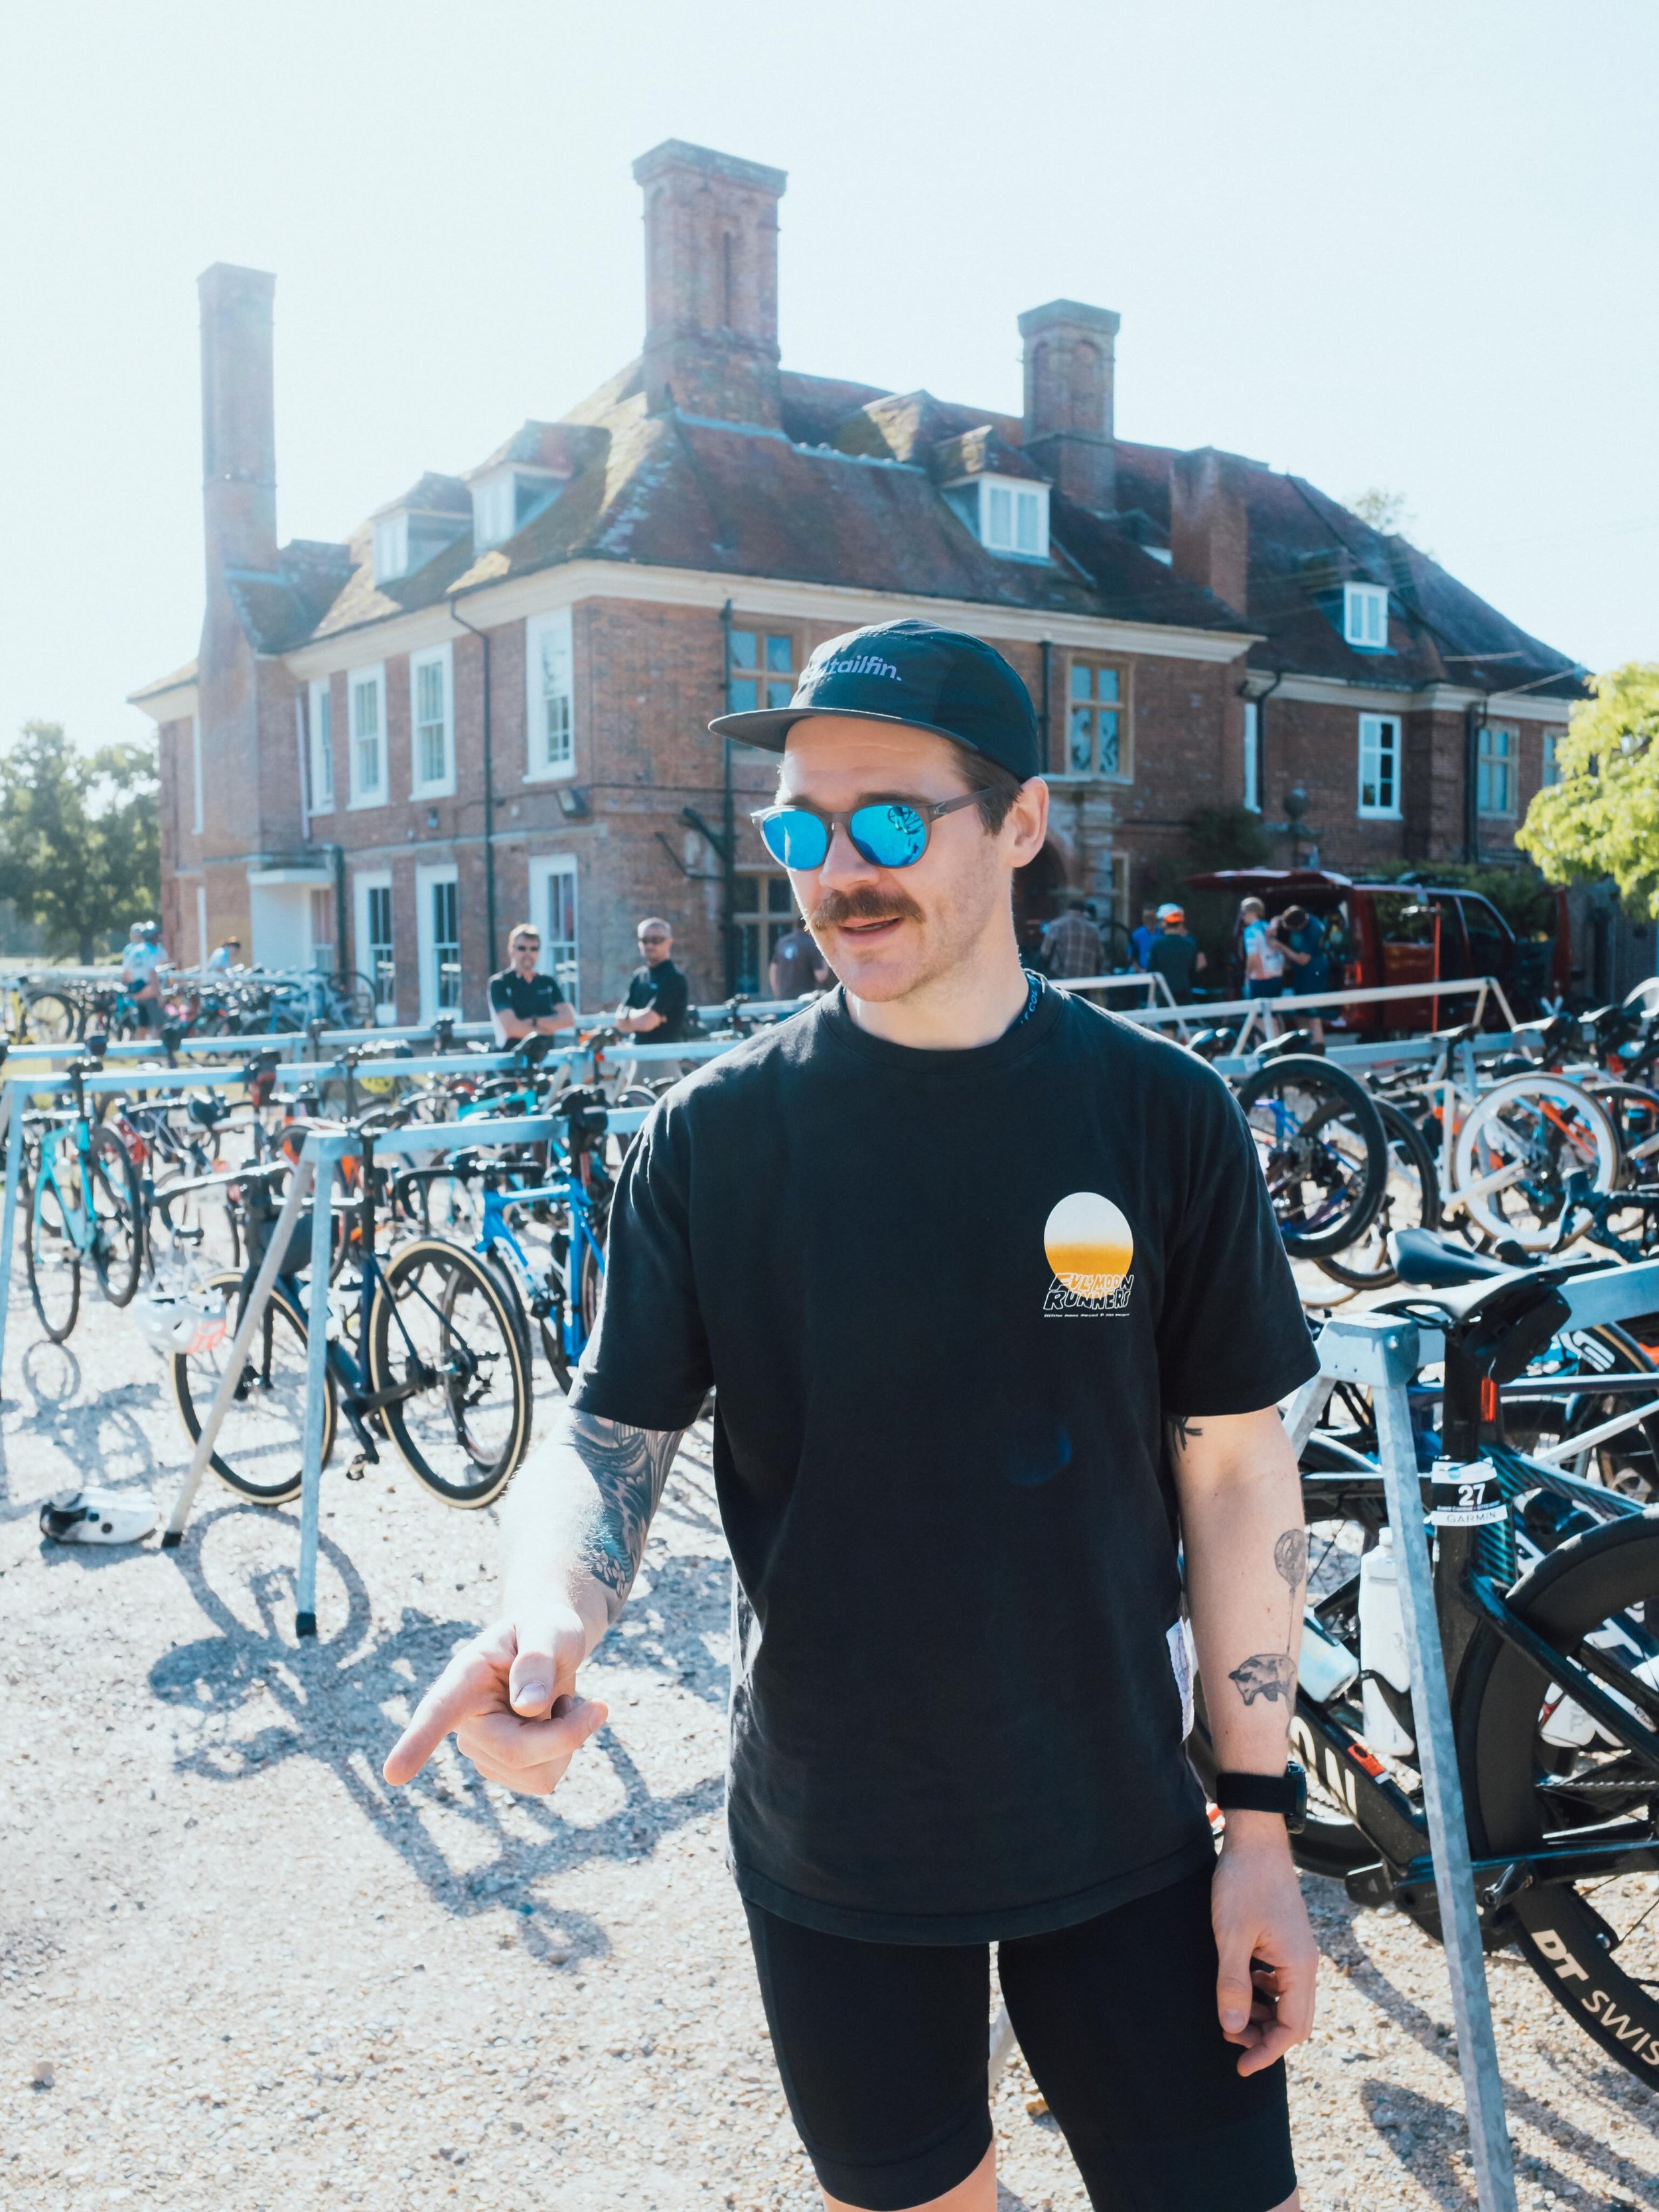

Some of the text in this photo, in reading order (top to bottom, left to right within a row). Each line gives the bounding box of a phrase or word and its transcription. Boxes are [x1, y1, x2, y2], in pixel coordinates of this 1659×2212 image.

[1043, 1289, 1131, 1310] RUNNERS
[1458, 1483, 1485, 1506] 27
[1447, 1512, 1496, 1523] GARMIN
[1531, 1929, 1589, 1981] DT
